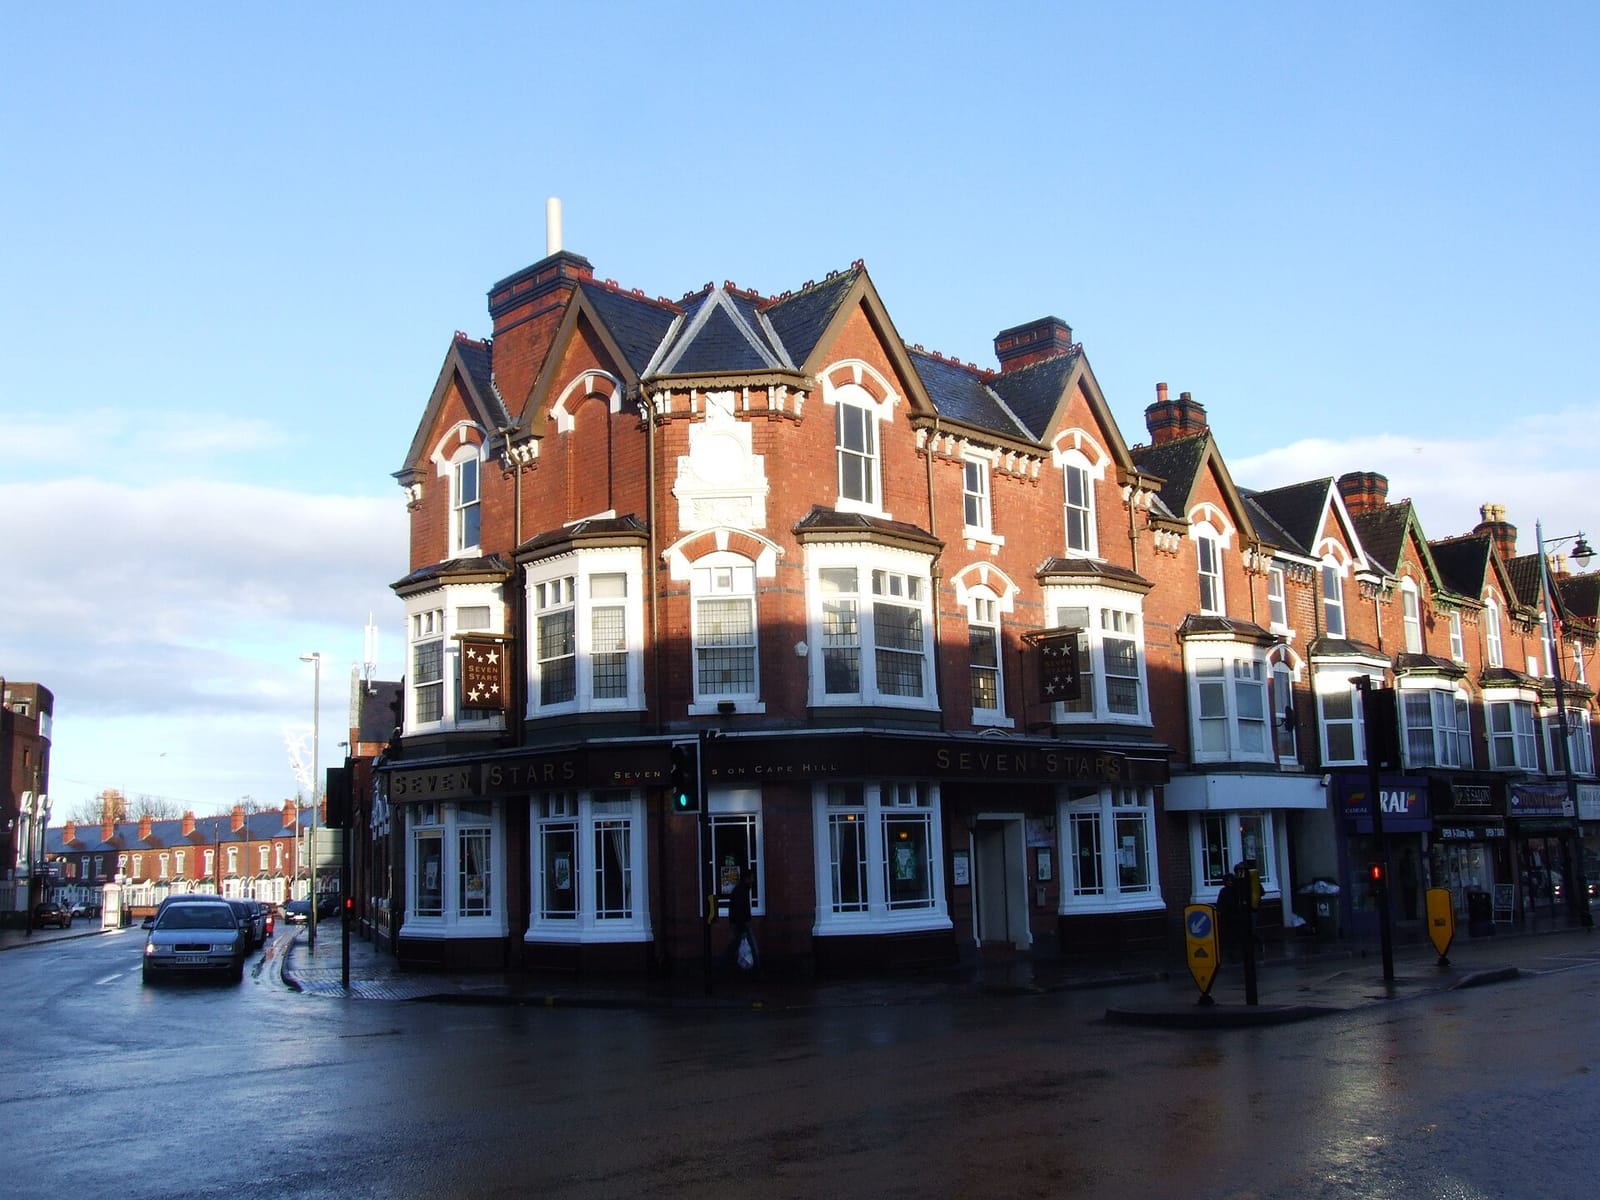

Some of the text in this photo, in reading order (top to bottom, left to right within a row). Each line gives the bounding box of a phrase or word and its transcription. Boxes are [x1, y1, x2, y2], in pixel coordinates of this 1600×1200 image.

[468, 665, 498, 673] SEVEN
[468, 673, 498, 681] STARS
[727, 767, 746, 775] ON
[754, 764, 793, 774] CAPE
[802, 762, 839, 772] HILL
[937, 749, 1121, 775] SEVEN STARS
[393, 761, 575, 794] SEVEN STARS
[613, 770, 662, 780] SEVEN
[1379, 791, 1409, 813] RAL
